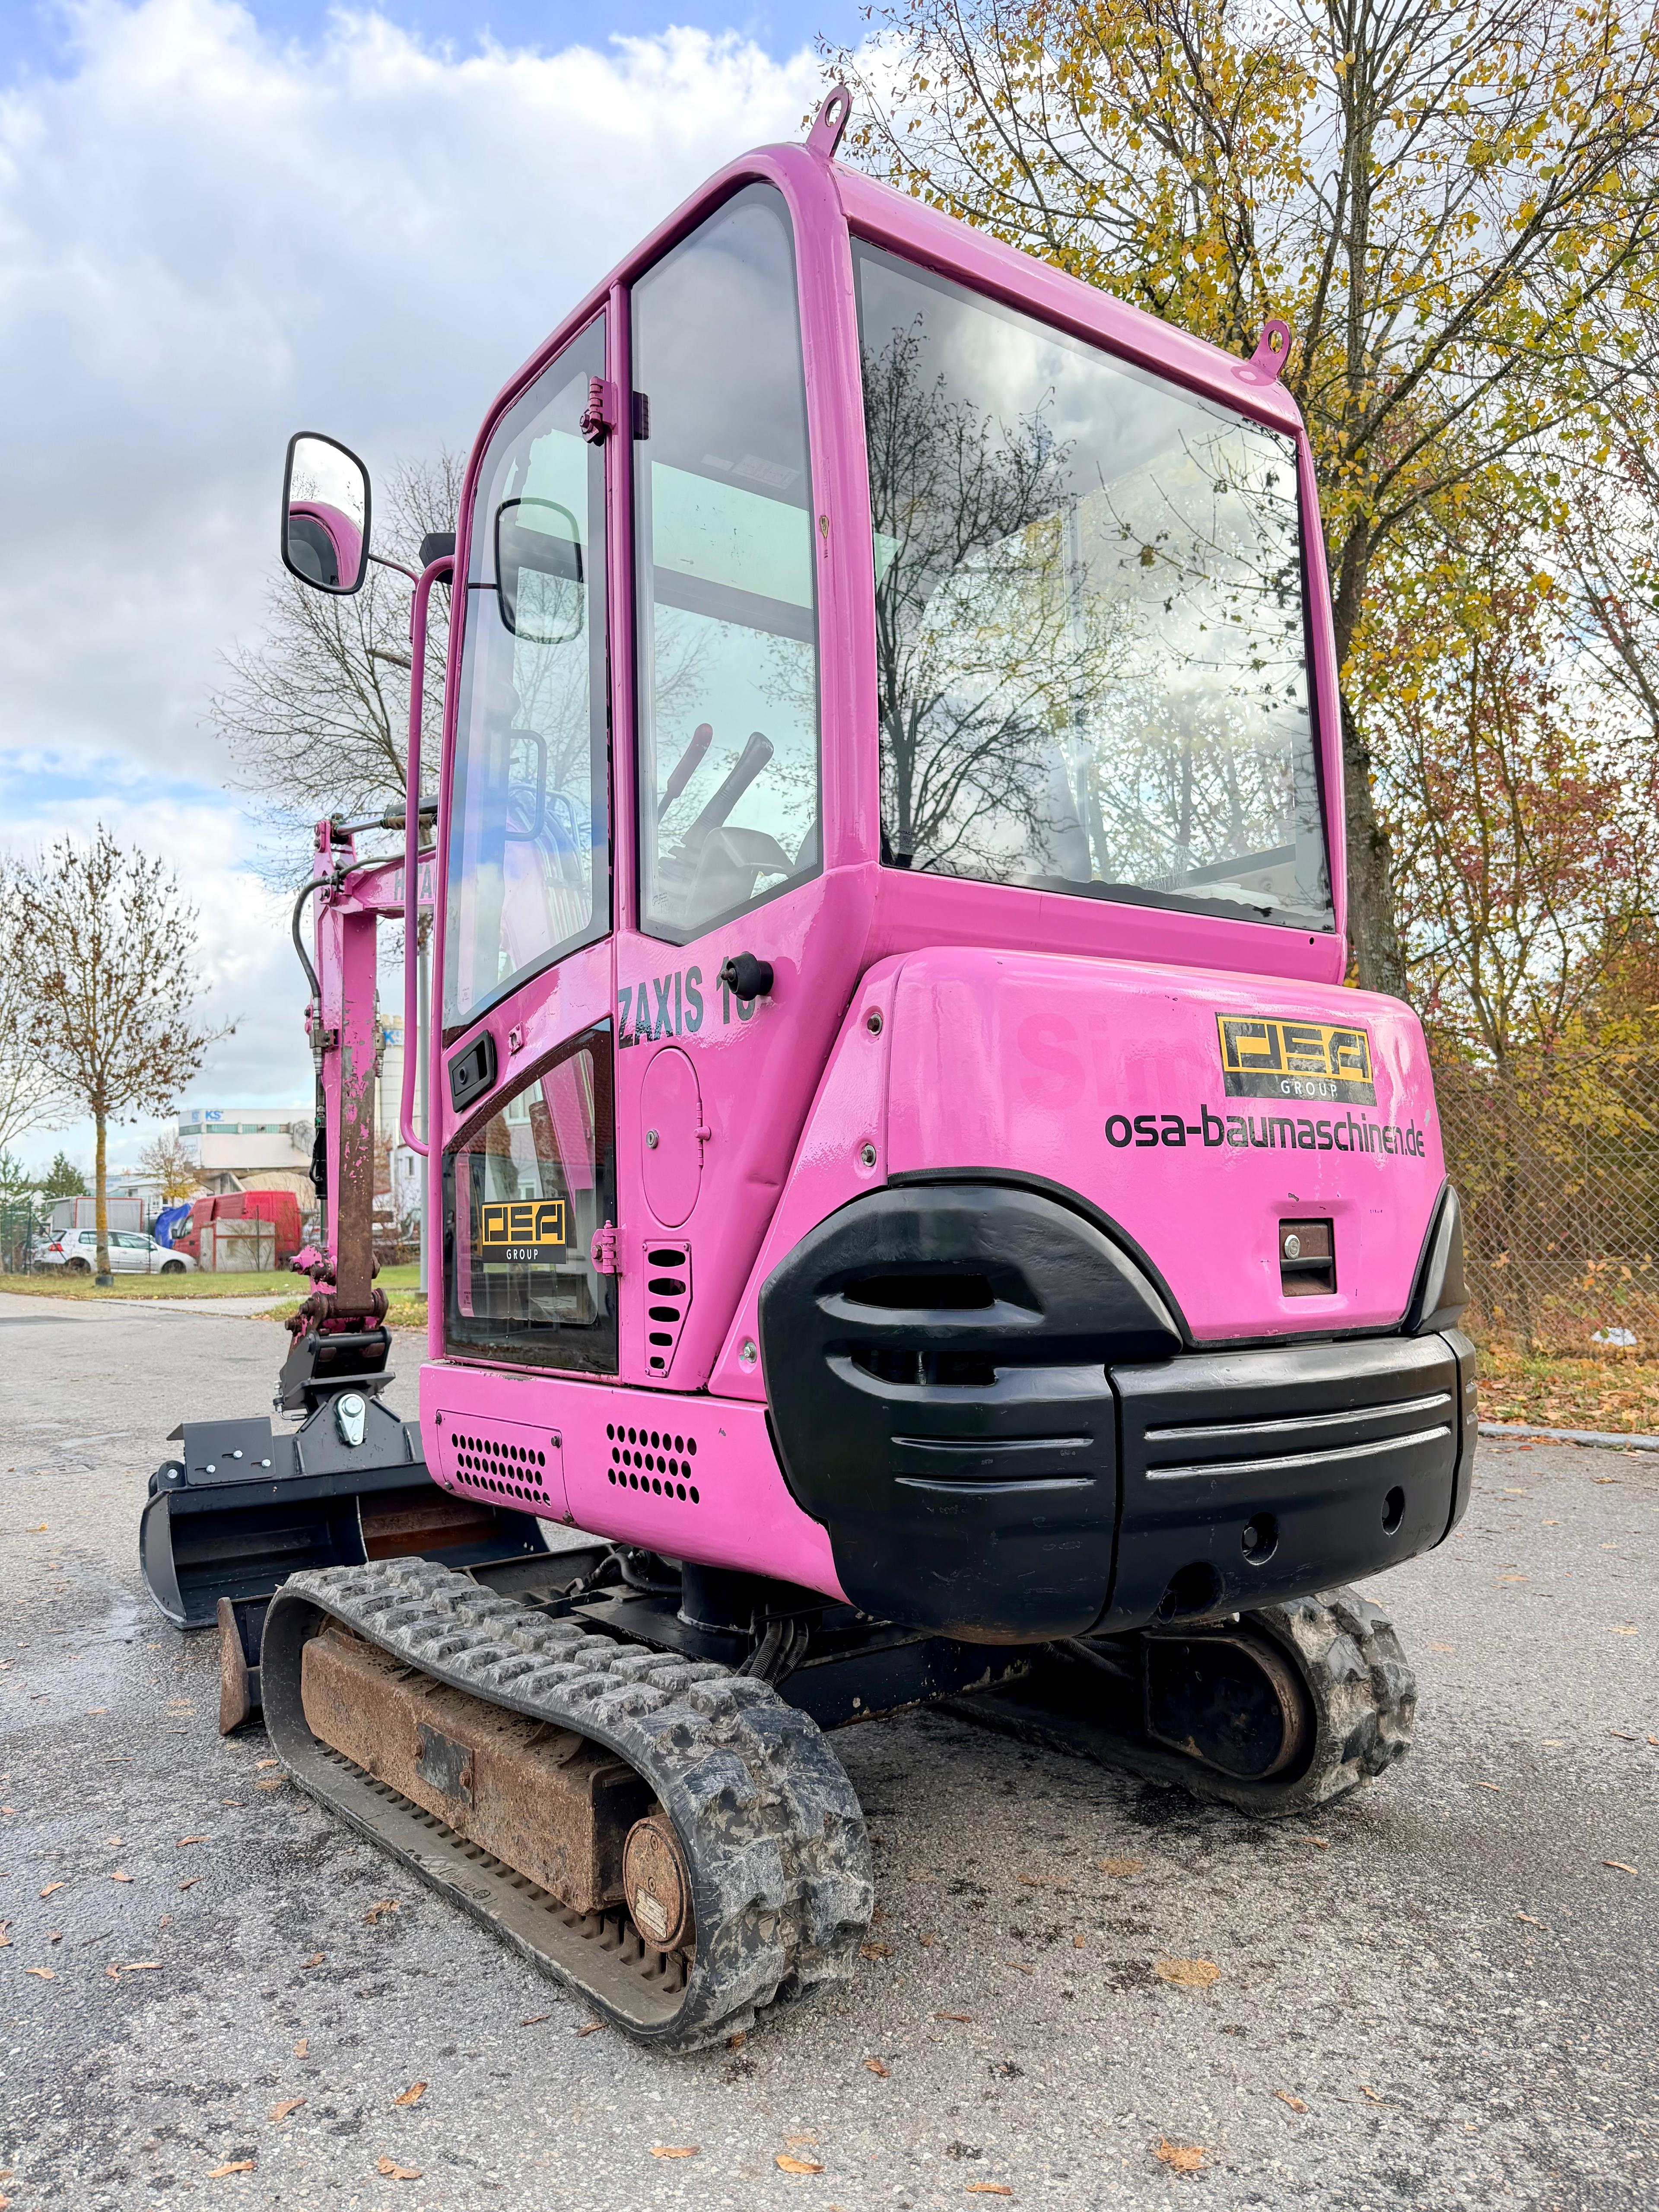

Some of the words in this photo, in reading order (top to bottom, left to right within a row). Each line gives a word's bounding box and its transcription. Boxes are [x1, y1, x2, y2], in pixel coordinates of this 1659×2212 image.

[618, 966, 704, 1049] ZAXIS
[1281, 1080, 1337, 1097] GROUP
[205, 1110, 221, 1119] KS
[1105, 1103, 1425, 1157] osa-baumaschinen.de
[506, 1249, 538, 1260] GROUP
